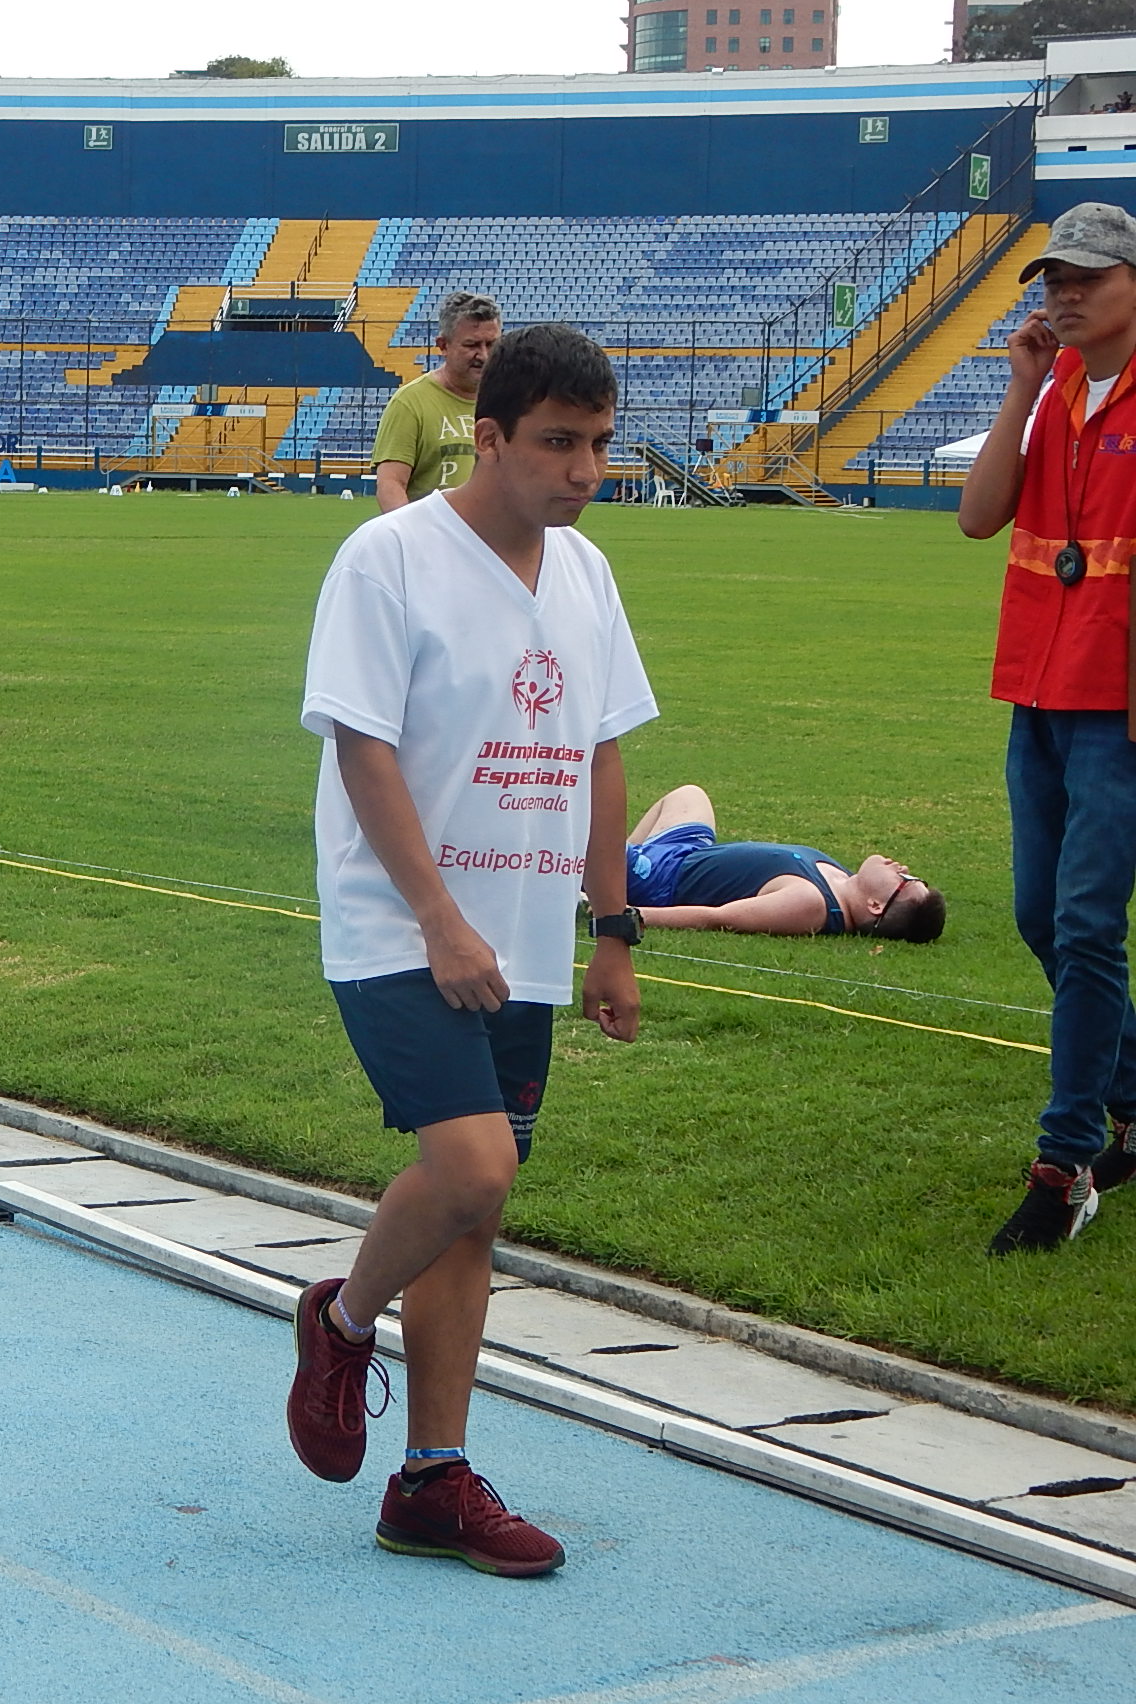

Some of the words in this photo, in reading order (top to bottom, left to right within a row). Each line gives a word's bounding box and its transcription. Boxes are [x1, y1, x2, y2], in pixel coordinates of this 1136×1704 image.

[297, 132, 367, 151] SALIDA
[374, 132, 386, 150] 2
[206, 405, 213, 415] 2
[760, 411, 767, 422] 3
[477, 741, 585, 763] Olimpiadas
[472, 766, 579, 789] Especiales
[498, 793, 568, 812] Guaemala
[437, 844, 522, 872] Equipo
[524, 852, 533, 869] e
[537, 849, 585, 876] Biale
